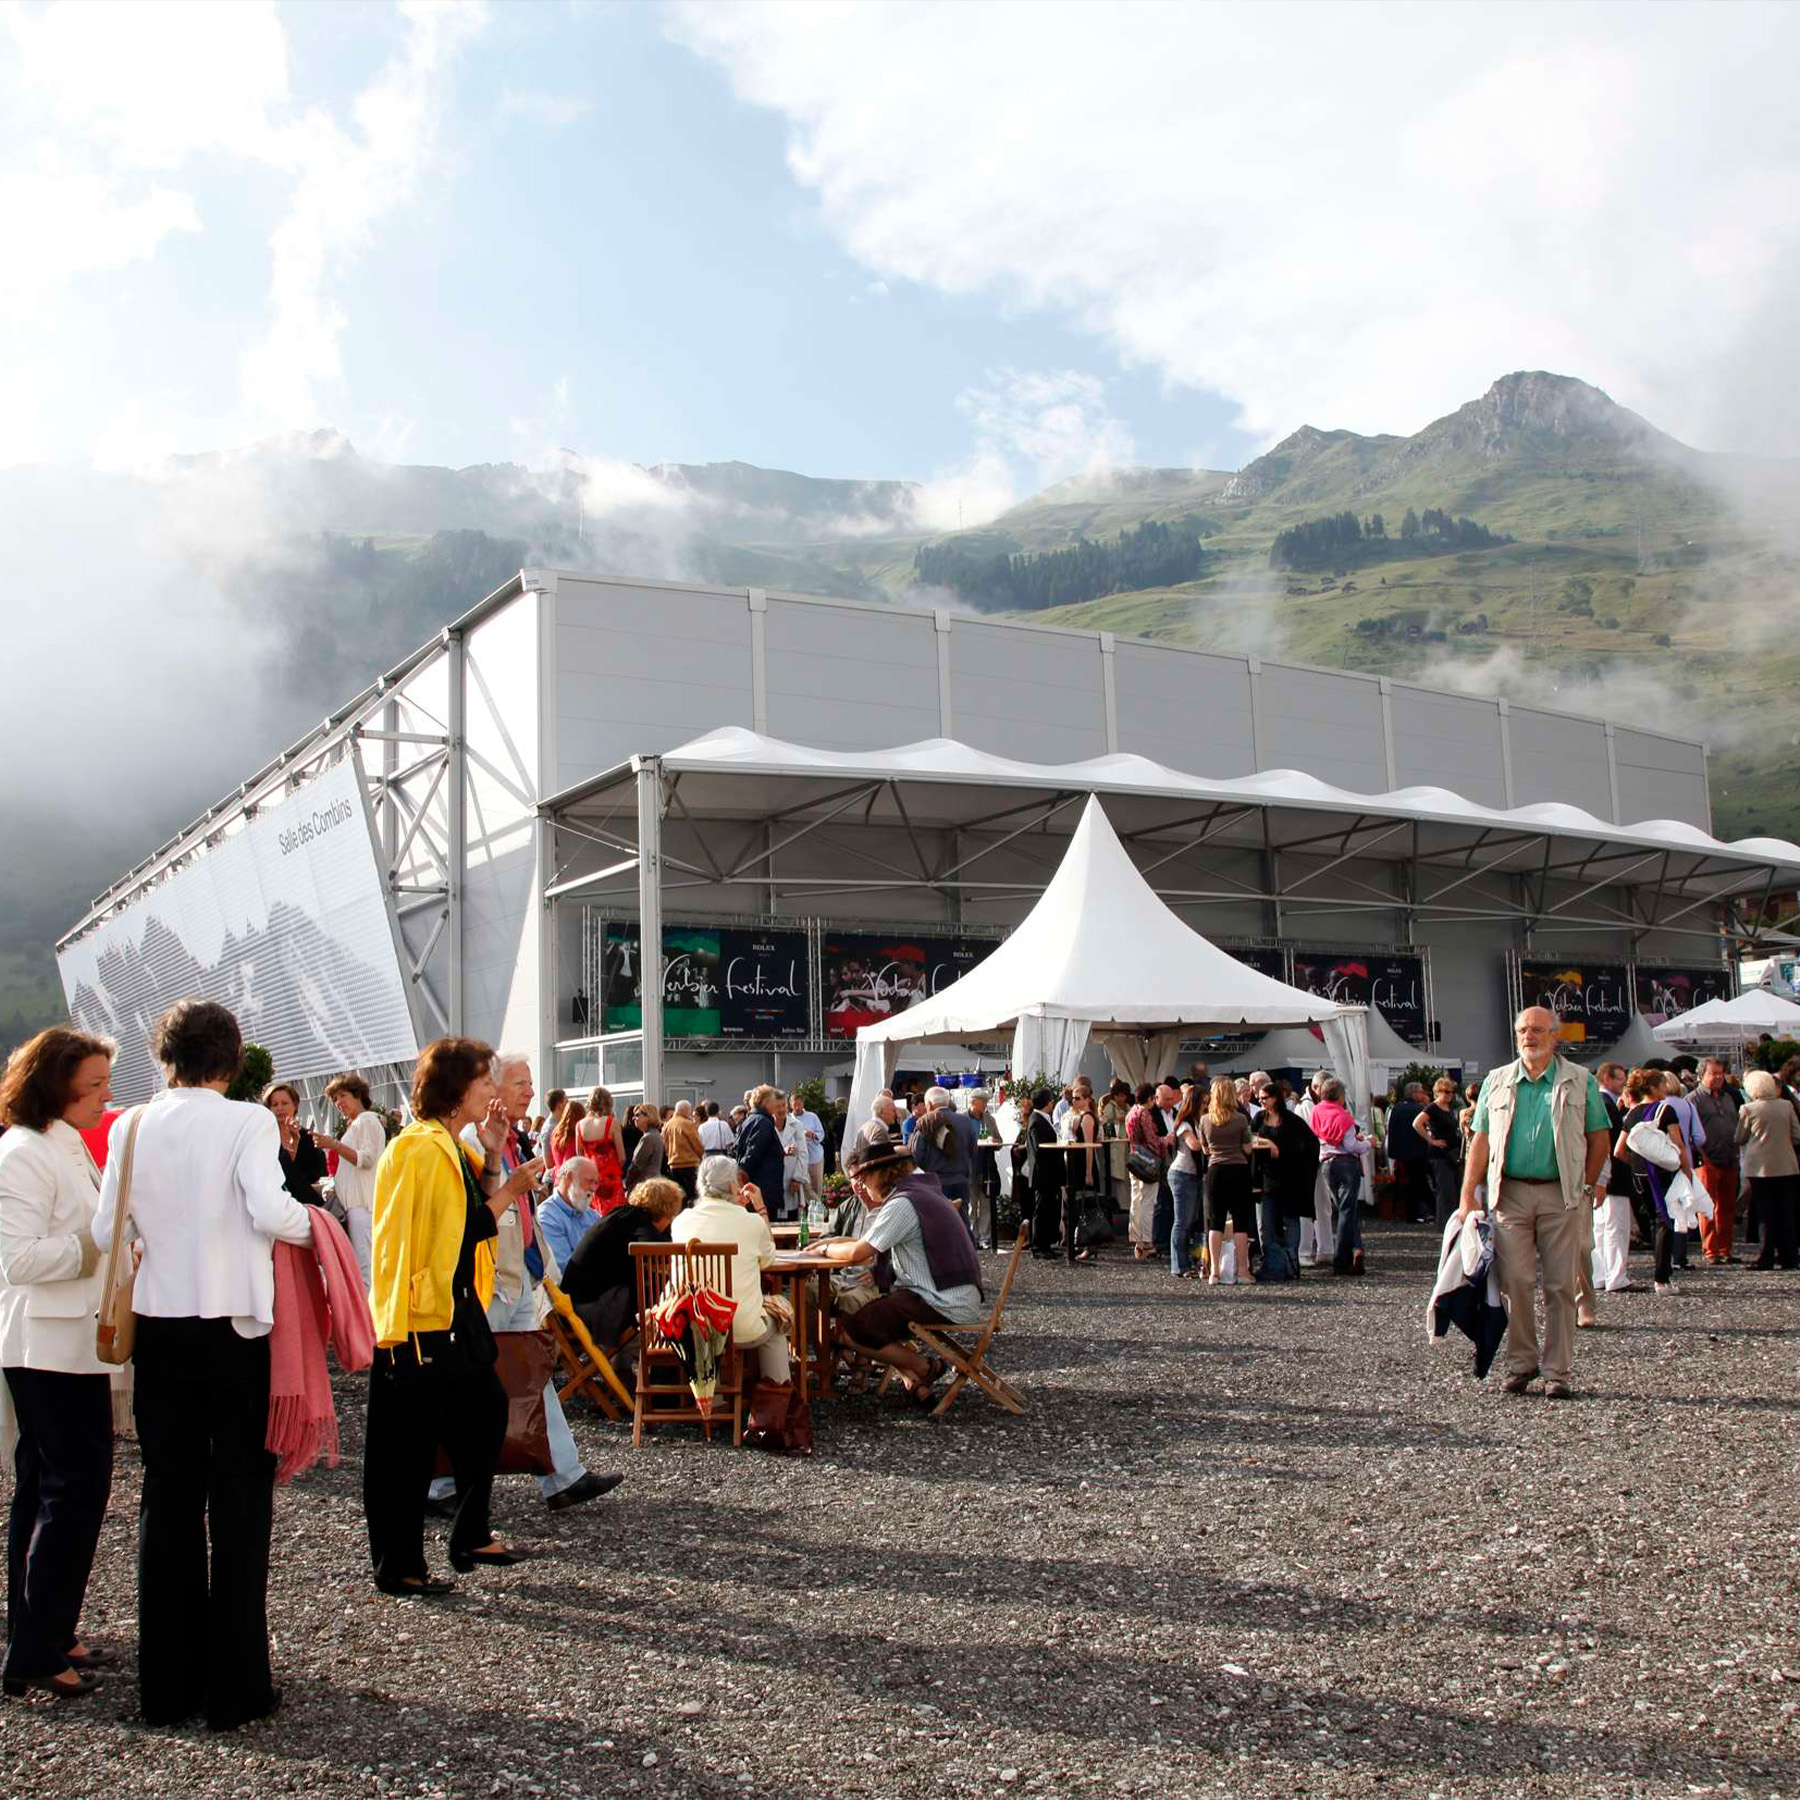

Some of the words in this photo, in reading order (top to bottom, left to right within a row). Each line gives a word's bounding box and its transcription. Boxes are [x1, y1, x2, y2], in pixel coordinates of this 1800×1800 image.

[278, 828, 300, 856] Salle
[298, 820, 315, 845] des
[312, 798, 353, 836] Combins
